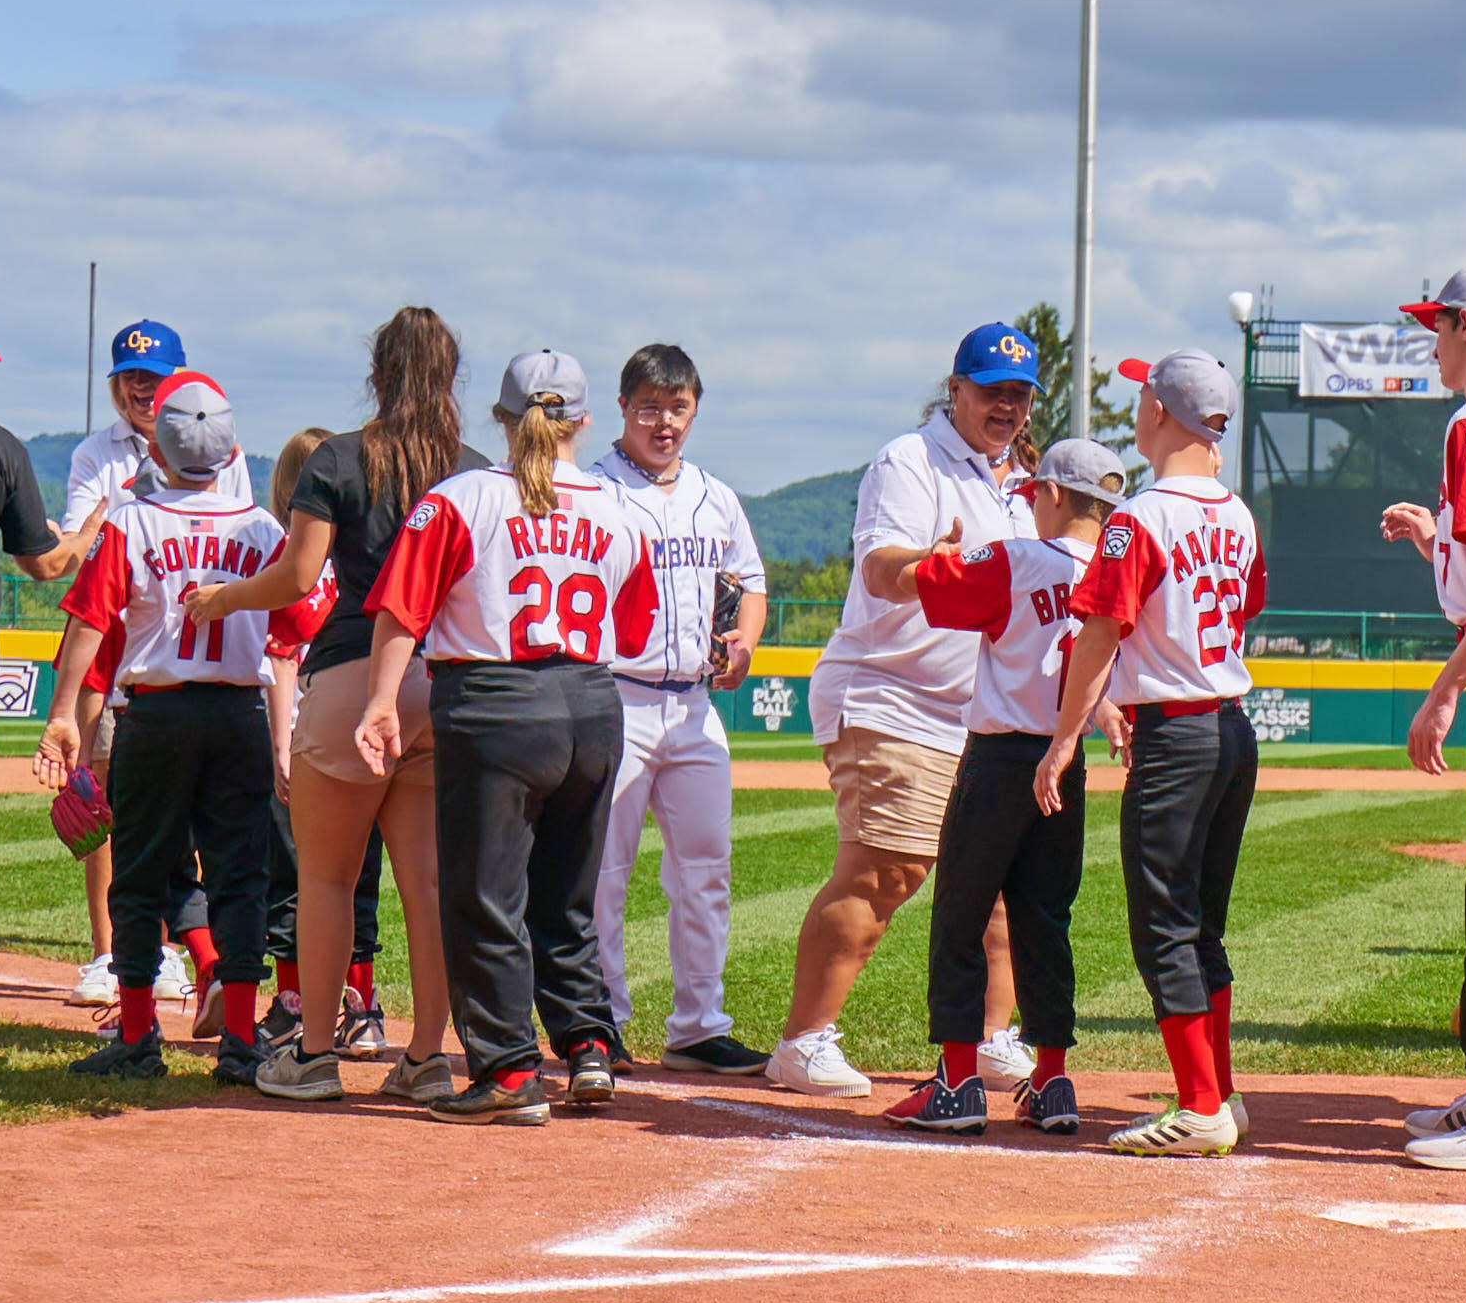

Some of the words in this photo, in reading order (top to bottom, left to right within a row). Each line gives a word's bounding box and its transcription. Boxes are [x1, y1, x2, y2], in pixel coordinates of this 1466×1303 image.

[127, 329, 153, 354] CP
[999, 335, 1026, 364] CP
[1347, 377, 1374, 392] PBS
[505, 513, 614, 565] REGAN
[651, 536, 728, 570] MBRIA
[508, 565, 608, 663] 28
[752, 687, 793, 704] PLAY
[752, 701, 792, 717] BALL
